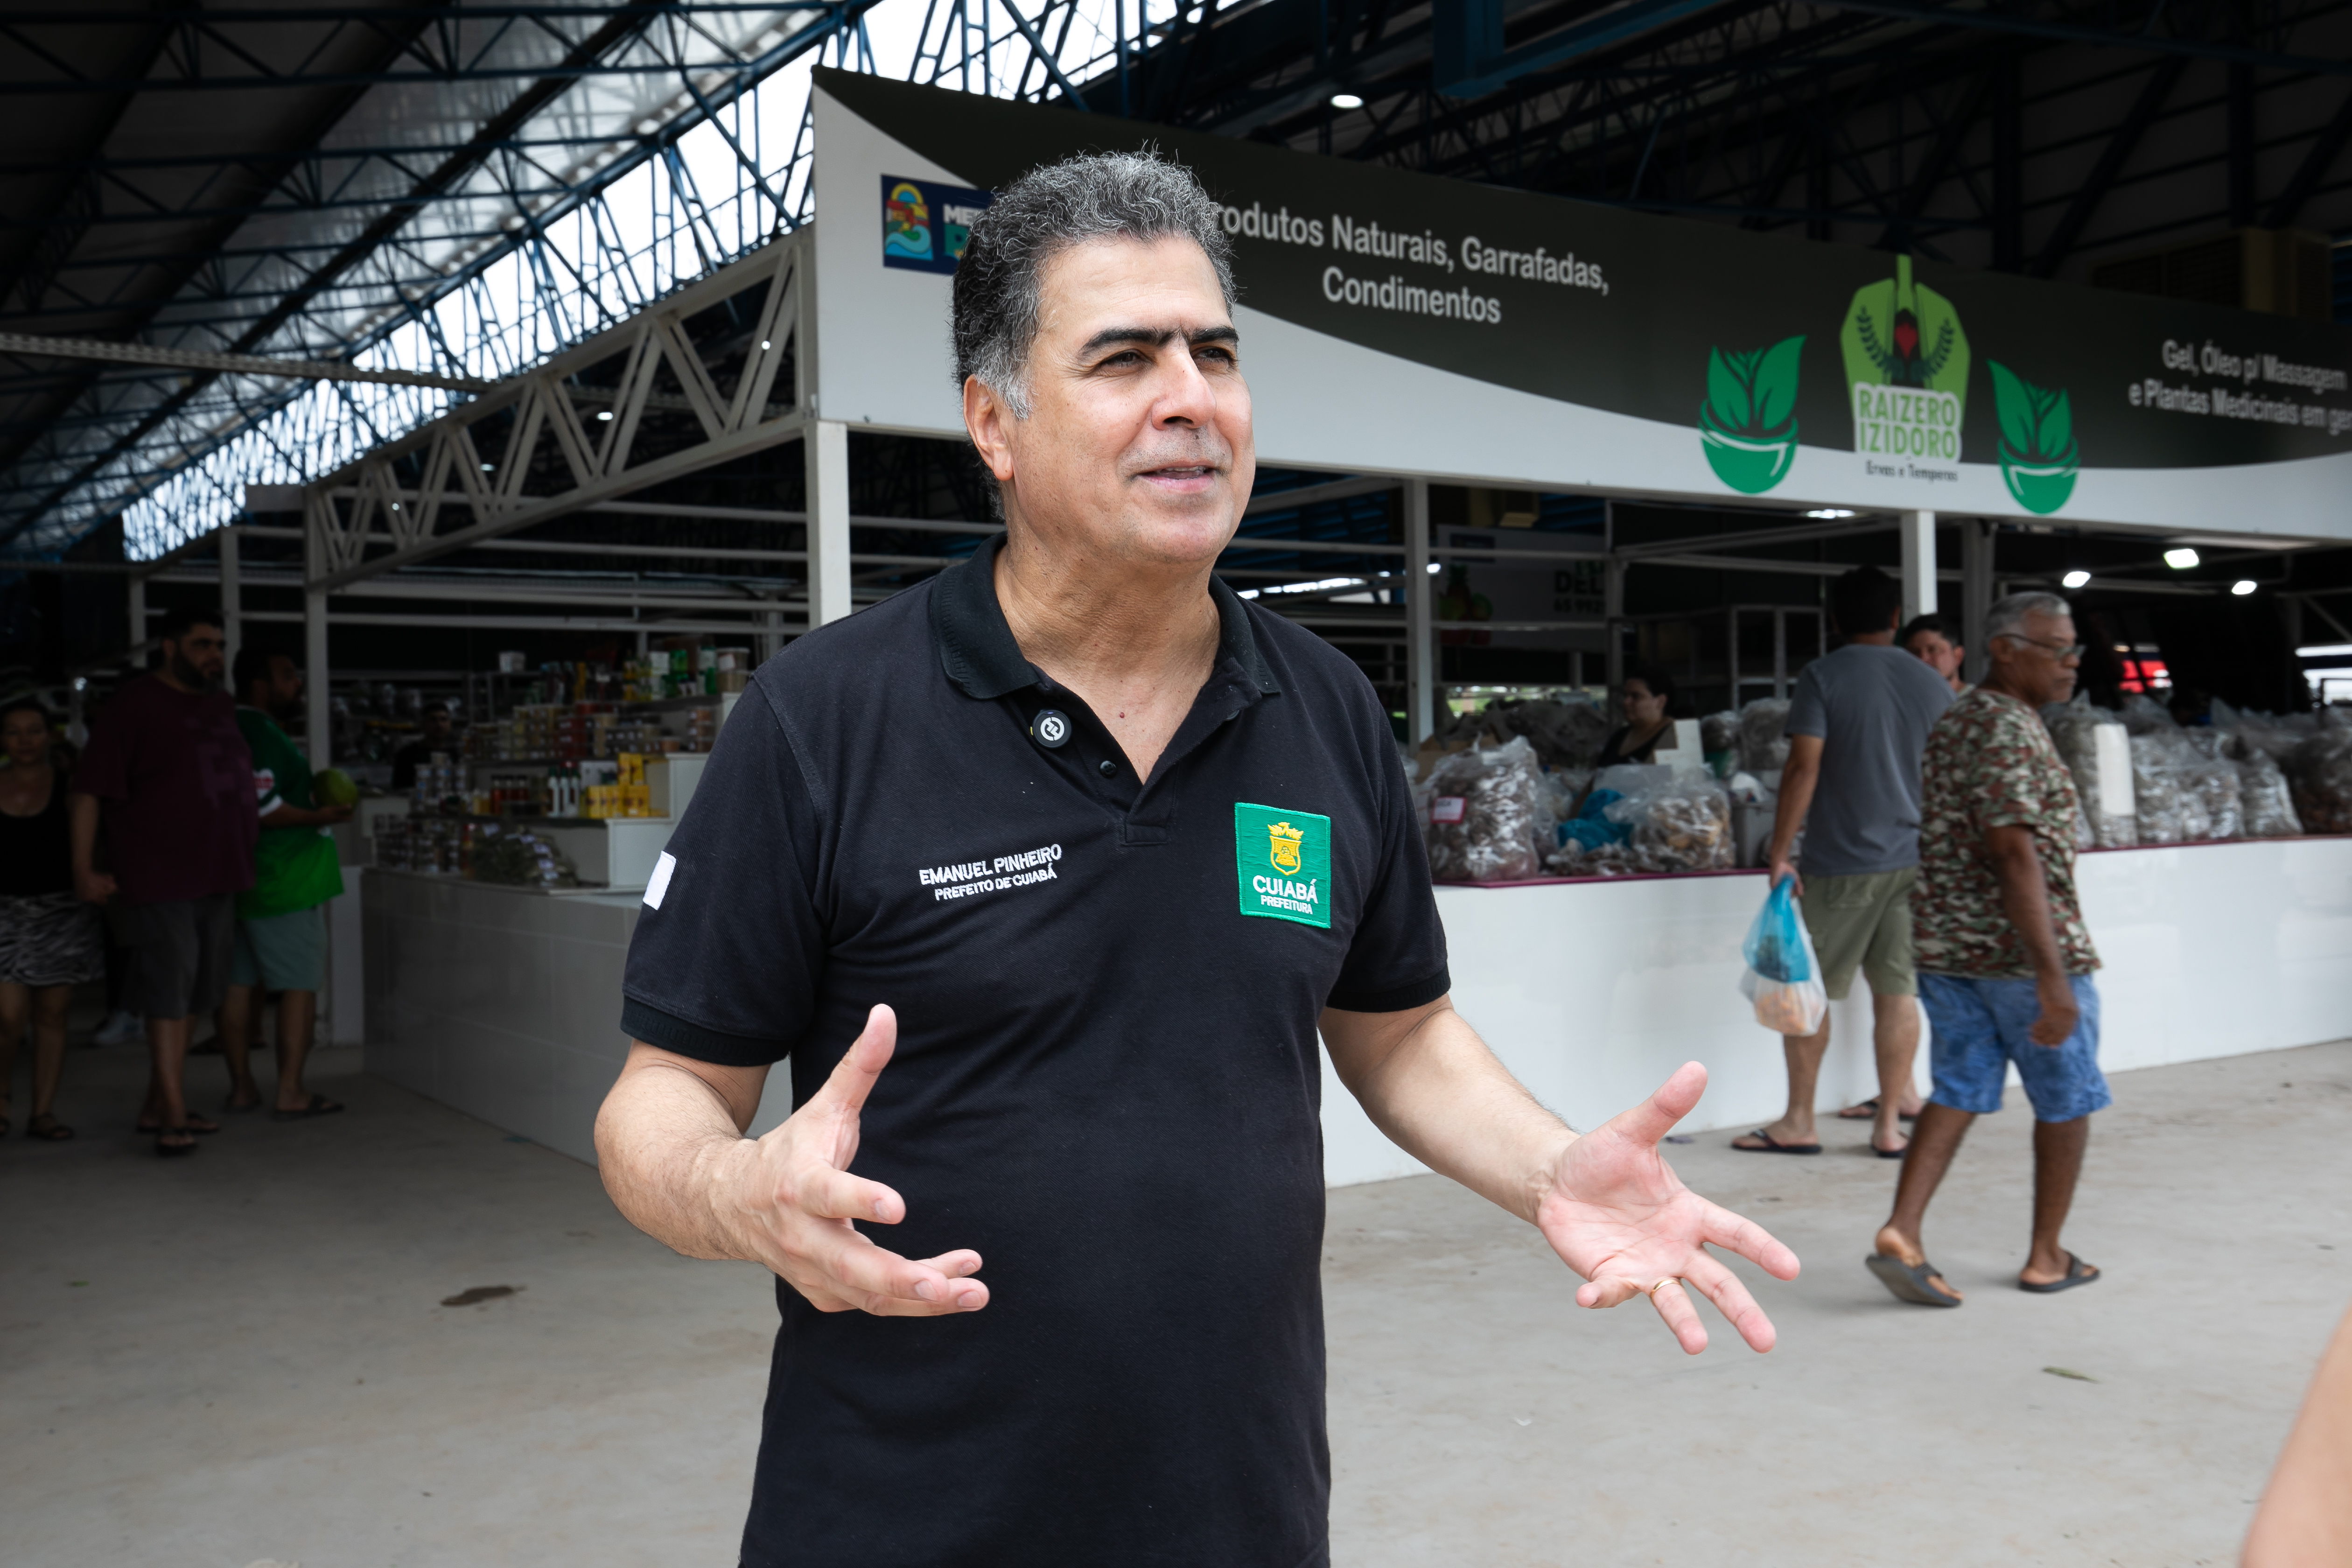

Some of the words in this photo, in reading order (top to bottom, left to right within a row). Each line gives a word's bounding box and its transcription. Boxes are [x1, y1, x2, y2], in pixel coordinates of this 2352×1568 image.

[1333, 215, 1455, 273] Naturais,
[1462, 237, 1610, 296] Garrafadas,
[1323, 266, 1502, 324] Condimentos
[1858, 389, 1955, 427] RAIZERO
[2128, 383, 2142, 406] e
[2143, 378, 2210, 414] Plantas
[1860, 422, 1956, 459] IZIDORO
[919, 861, 994, 885] EMANUEL
[994, 844, 1062, 873] PINHEIRO
[935, 879, 994, 901] PREFEITO
[995, 876, 1012, 889] DE
[1012, 862, 1057, 886] CUIABÁ
[1253, 875, 1319, 904] CUIABÁ
[1260, 895, 1313, 915] PREFEITURA
